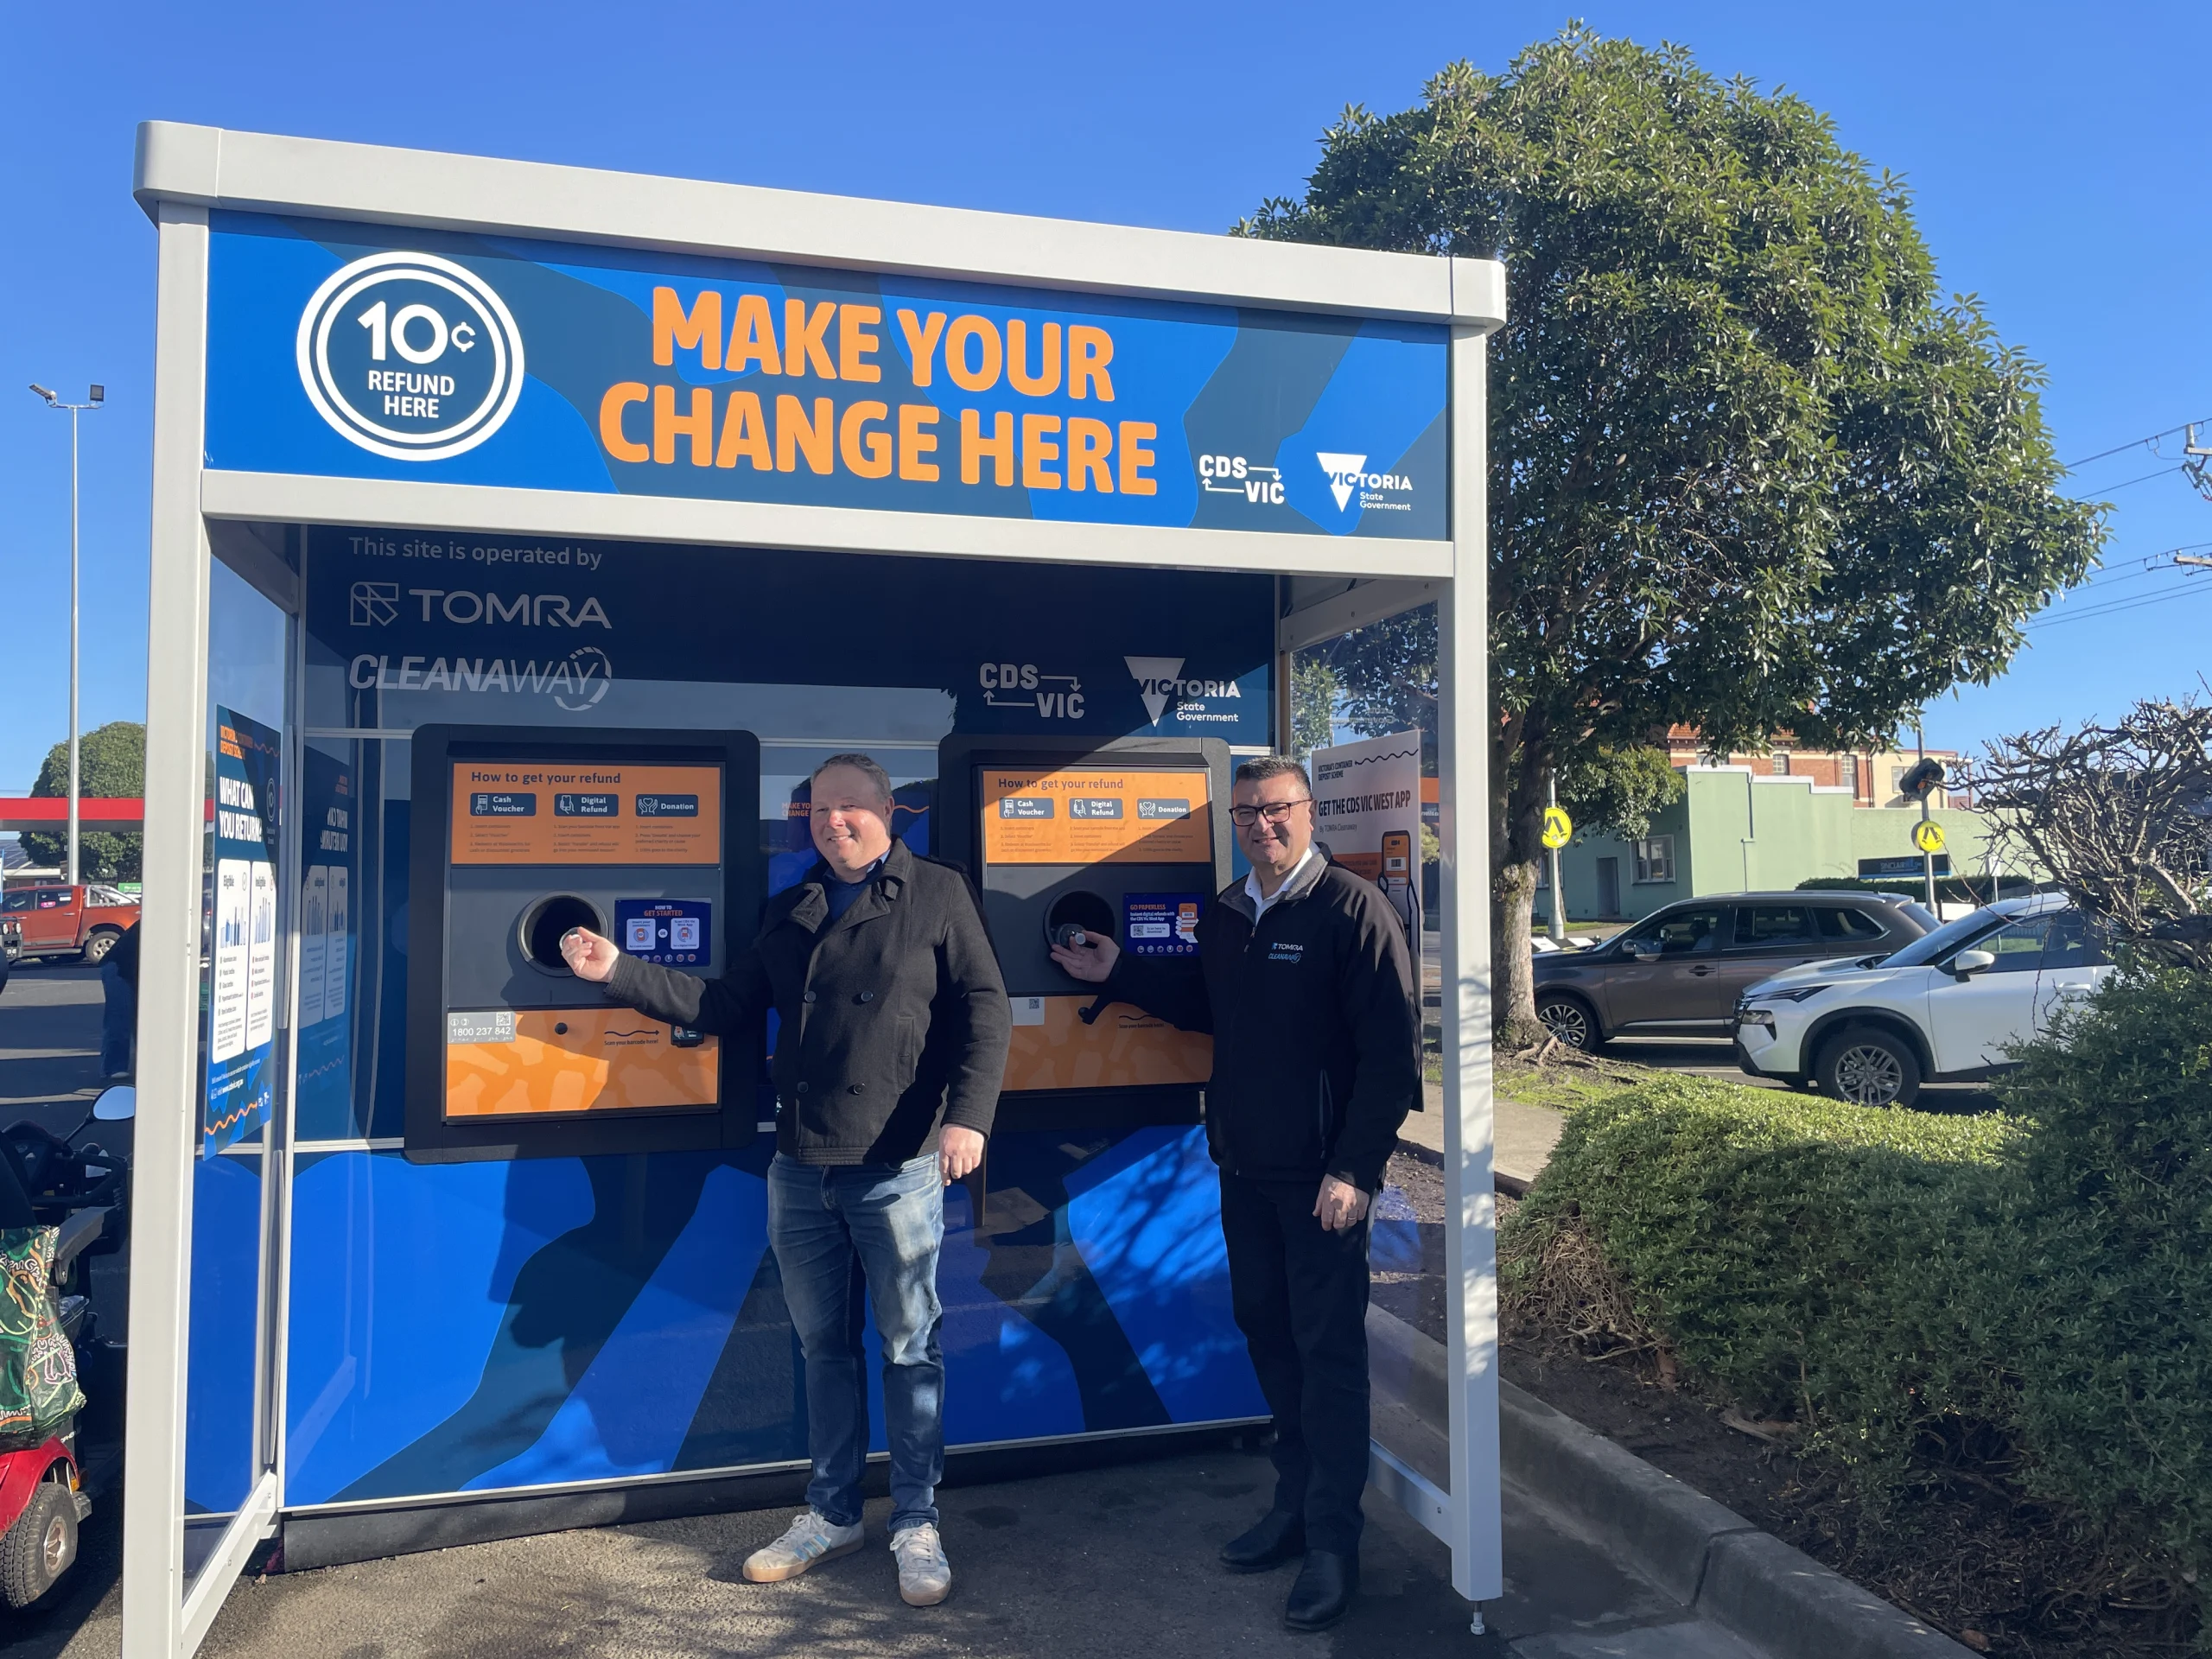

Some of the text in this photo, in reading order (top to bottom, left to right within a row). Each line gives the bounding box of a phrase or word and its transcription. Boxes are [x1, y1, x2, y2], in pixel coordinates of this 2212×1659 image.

[653, 287, 1115, 401] MAKE YOUR
[368, 371, 454, 396] REFUND
[384, 394, 439, 419] HERE
[600, 381, 1157, 495] CHANGE HERE
[1199, 454, 1247, 479] CDS
[1245, 480, 1285, 505] VIC
[1327, 471, 1413, 491] VICTORIA
[1359, 500, 1411, 511] Government
[1360, 492, 1383, 501] State
[348, 537, 602, 570] This site is operated by
[409, 588, 612, 629] TOMRA
[349, 654, 599, 695] CLEANAWAY
[980, 663, 1038, 690] CDS
[1136, 678, 1241, 698] VICTORIA
[1037, 693, 1084, 719] VIC
[1176, 702, 1205, 711] State
[1176, 712, 1238, 722] Government
[471, 772, 620, 785] How to get your refund
[998, 779, 1124, 791] How to get your refund
[219, 776, 255, 810] WHAT CAN
[581, 797, 607, 805] Digital
[1319, 790, 1410, 817] GET THE CDS VIC WEST APP
[660, 802, 694, 810] Donation
[1018, 808, 1045, 817] Voucher
[219, 810, 234, 839] YOU
[235, 814, 263, 842] RETURN?
[494, 1027, 511, 1035] 842
